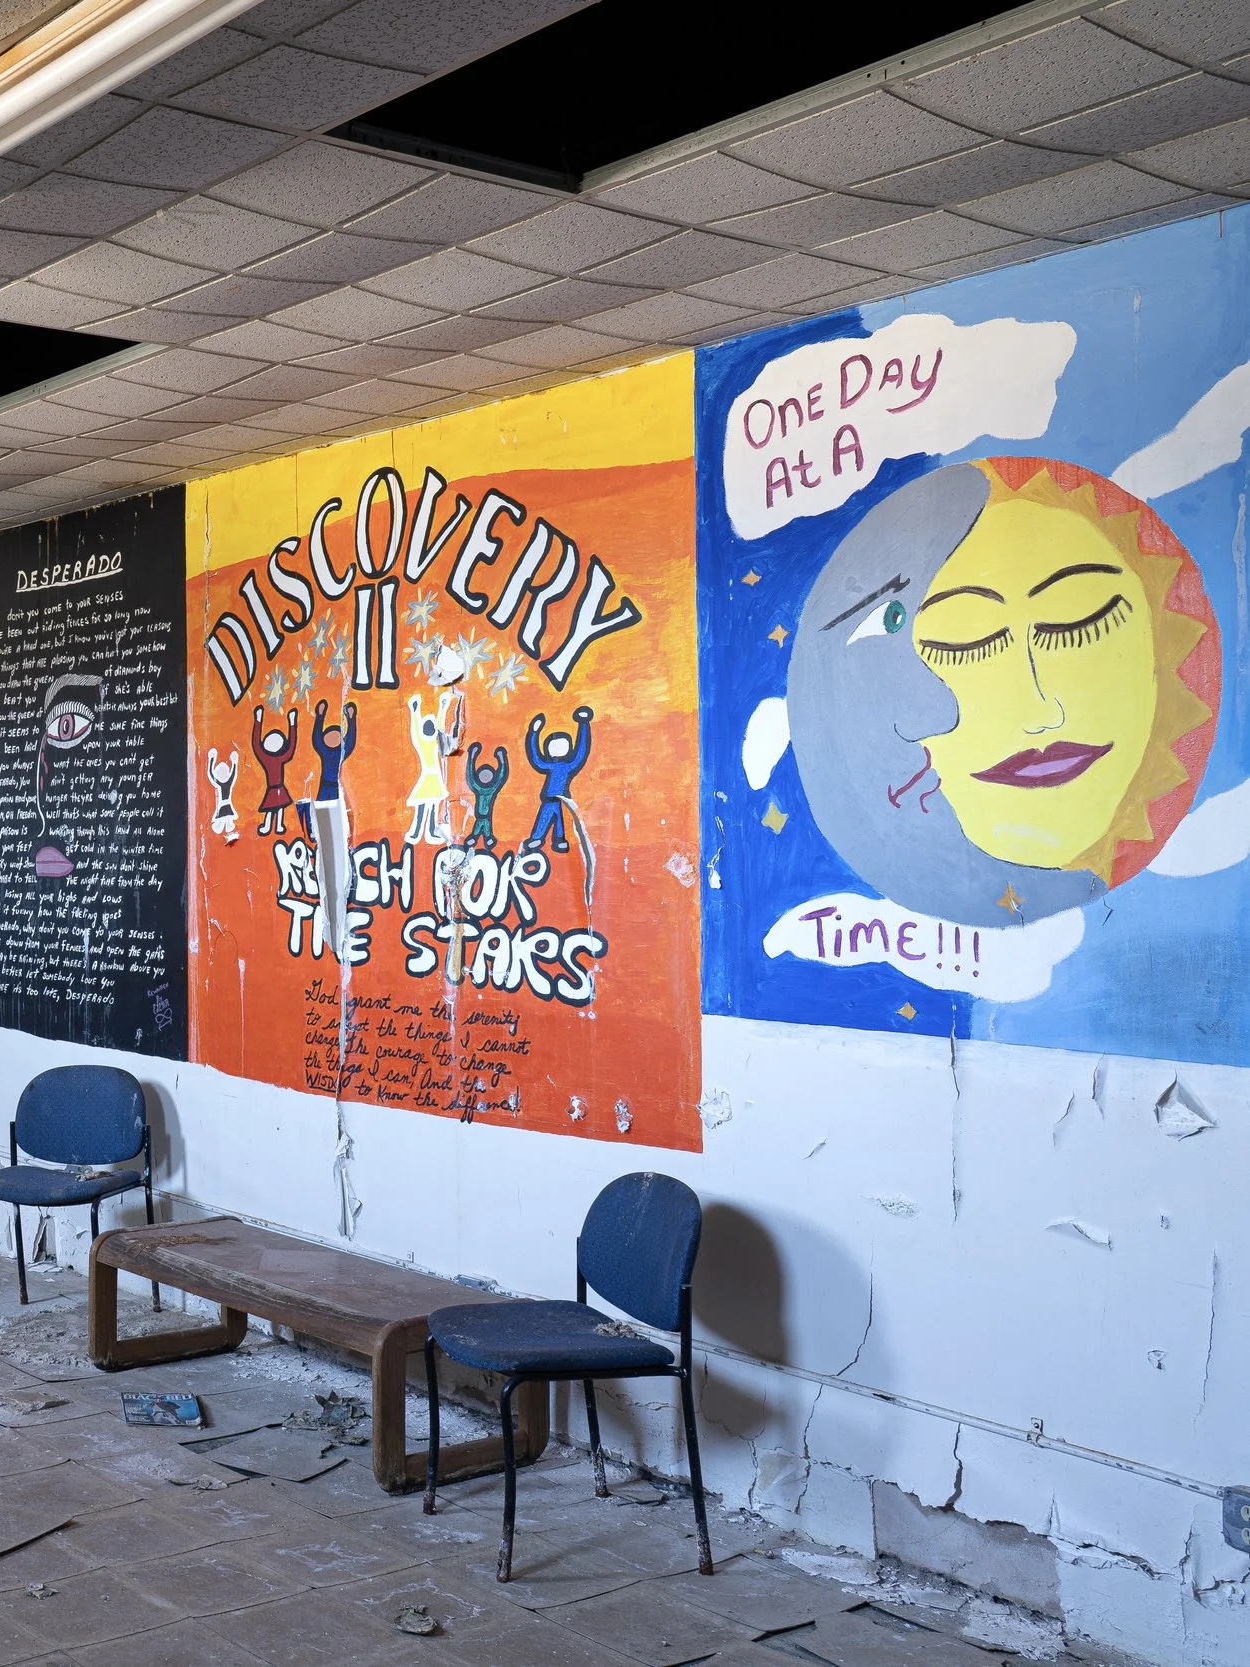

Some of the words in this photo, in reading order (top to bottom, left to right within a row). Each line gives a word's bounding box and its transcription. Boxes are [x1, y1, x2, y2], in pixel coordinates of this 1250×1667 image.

[766, 450, 821, 509] At
[833, 424, 864, 477] A
[16, 552, 121, 590] DESPERADO
[205, 466, 642, 707] DISCOVERY
[352, 576, 399, 690] II
[273, 838, 415, 914] RECH
[402, 911, 609, 1008] STARS
[305, 979, 339, 1005] God
[346, 993, 391, 1020] grant
[393, 1005, 423, 1016] me
[462, 1010, 520, 1036] serenity
[306, 1007, 321, 1025] to
[376, 1019, 397, 1037] the
[406, 1025, 453, 1055] things
[459, 1033, 470, 1051] I
[477, 1040, 531, 1055] cannot
[304, 1051, 322, 1068] the
[368, 1059, 379, 1082] I
[420, 1069, 453, 1091] And
[355, 1079, 372, 1095] to
[413, 1090, 438, 1107] the
[375, 1046, 429, 1076] courage
[460, 1053, 511, 1087] change
